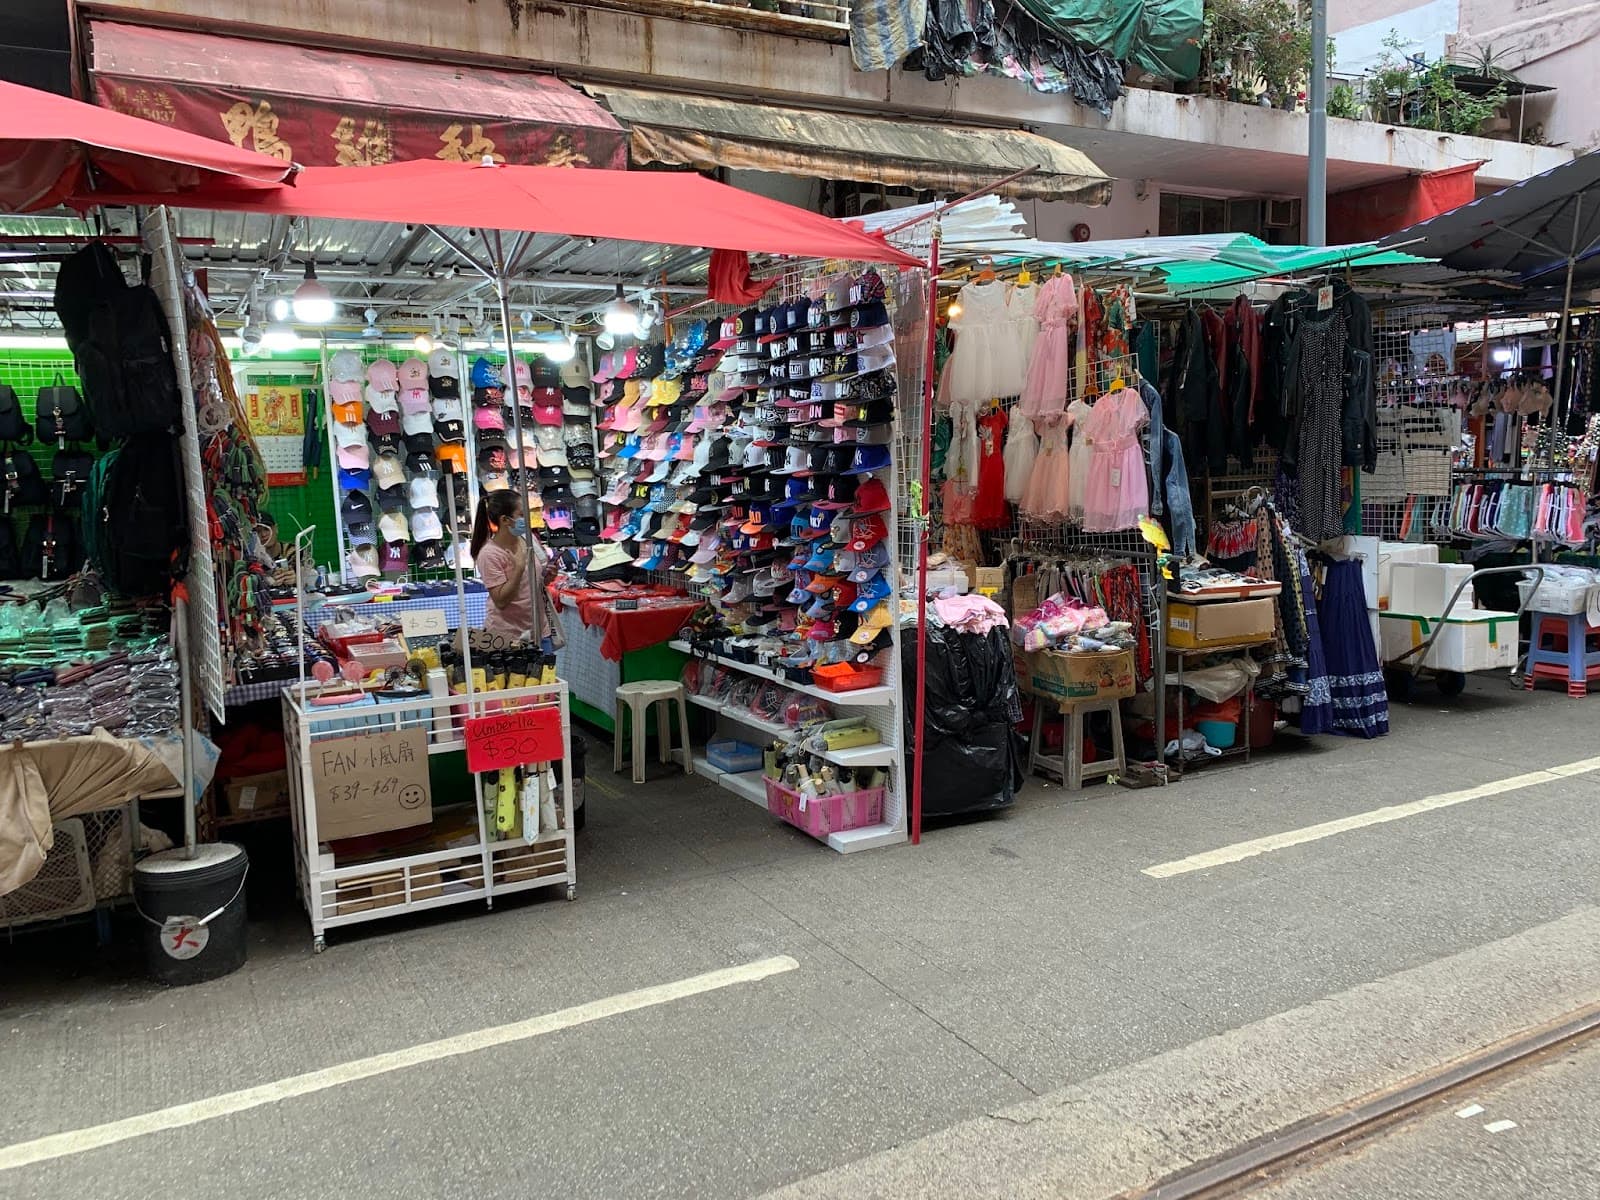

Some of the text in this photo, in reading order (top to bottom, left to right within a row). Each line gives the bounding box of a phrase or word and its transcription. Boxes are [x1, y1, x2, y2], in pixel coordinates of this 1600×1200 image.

[409, 616, 438, 629] $5
[483, 737, 538, 760] $30
[322, 748, 356, 776] FAN
